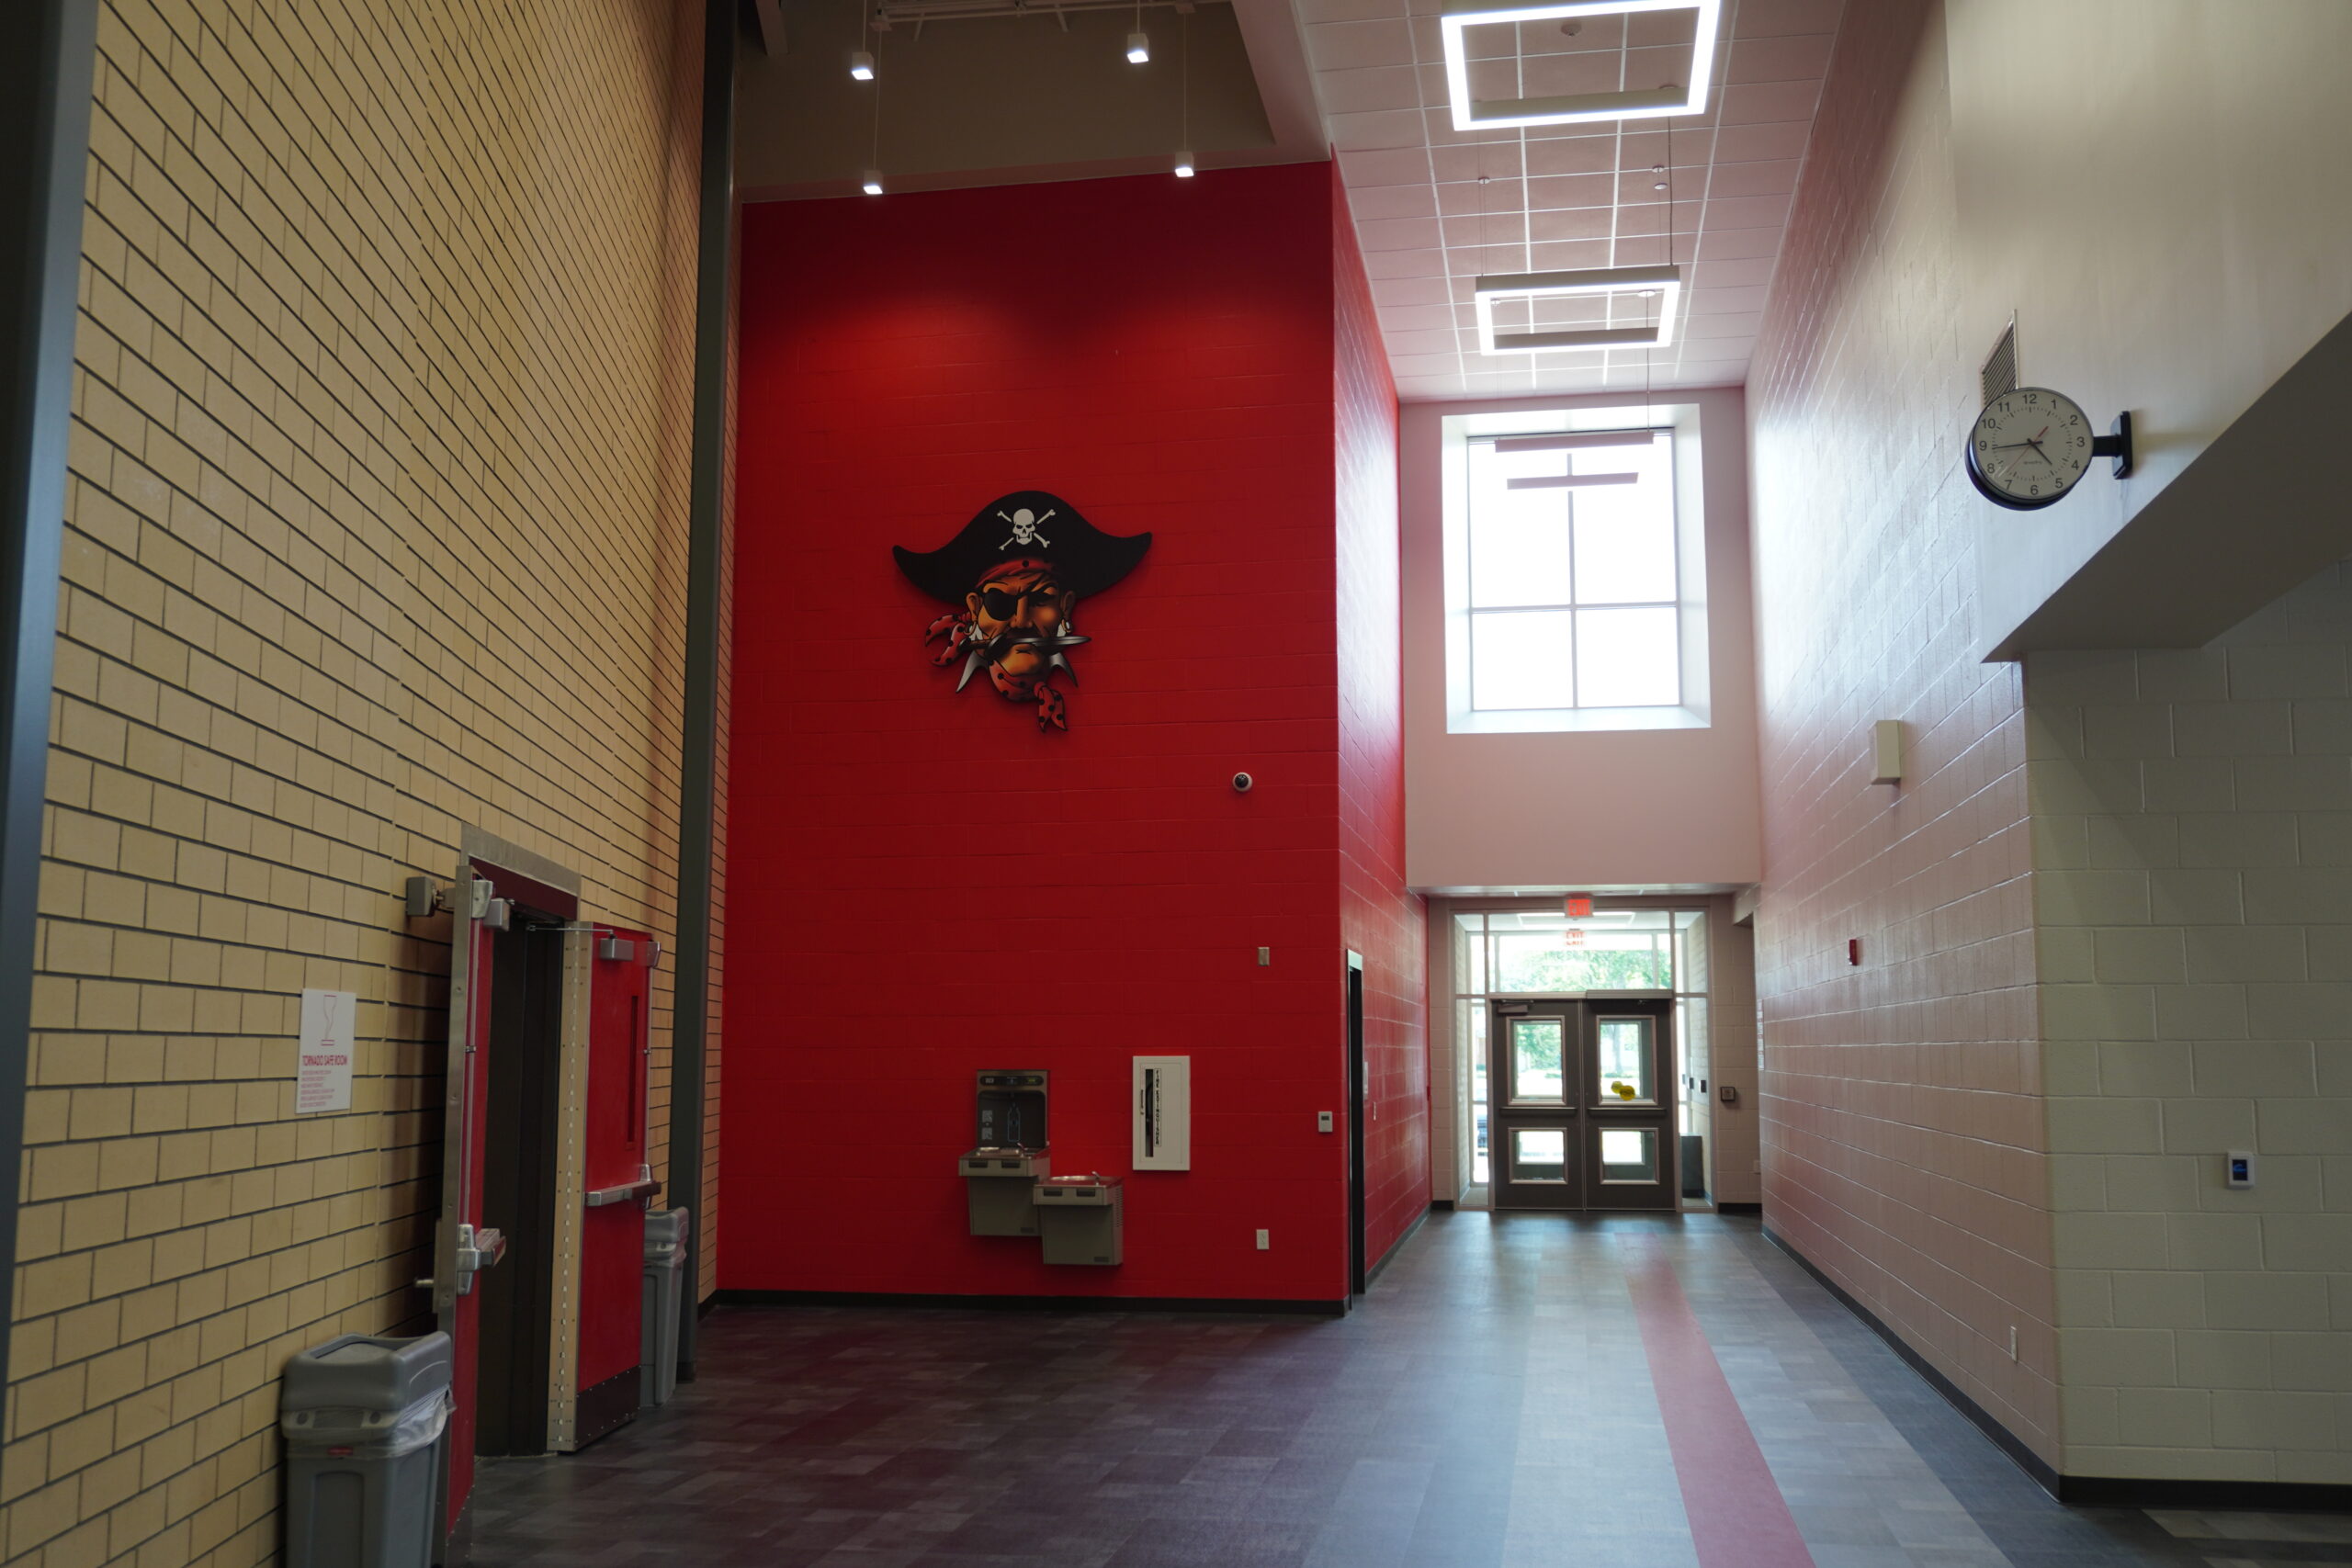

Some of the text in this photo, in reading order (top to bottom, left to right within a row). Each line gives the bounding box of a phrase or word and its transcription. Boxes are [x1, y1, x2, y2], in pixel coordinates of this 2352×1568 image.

[2023, 394, 2037, 404] 12
[2051, 400, 2056, 409] 1
[1997, 402, 2010, 412] 11
[1982, 418, 1996, 429] 10
[2070, 414, 2078, 425] 2
[1979, 440, 1987, 451] 9
[2076, 436, 2085, 447] 3
[1986, 463, 1995, 474] 8
[2071, 460, 2080, 470] 4
[2005, 479, 2012, 491] 7
[2055, 478, 2064, 489] 5
[2030, 485, 2039, 495] 6
[1568, 898, 1590, 916] EXIT
[302, 1055, 322, 1066] TORNADO
